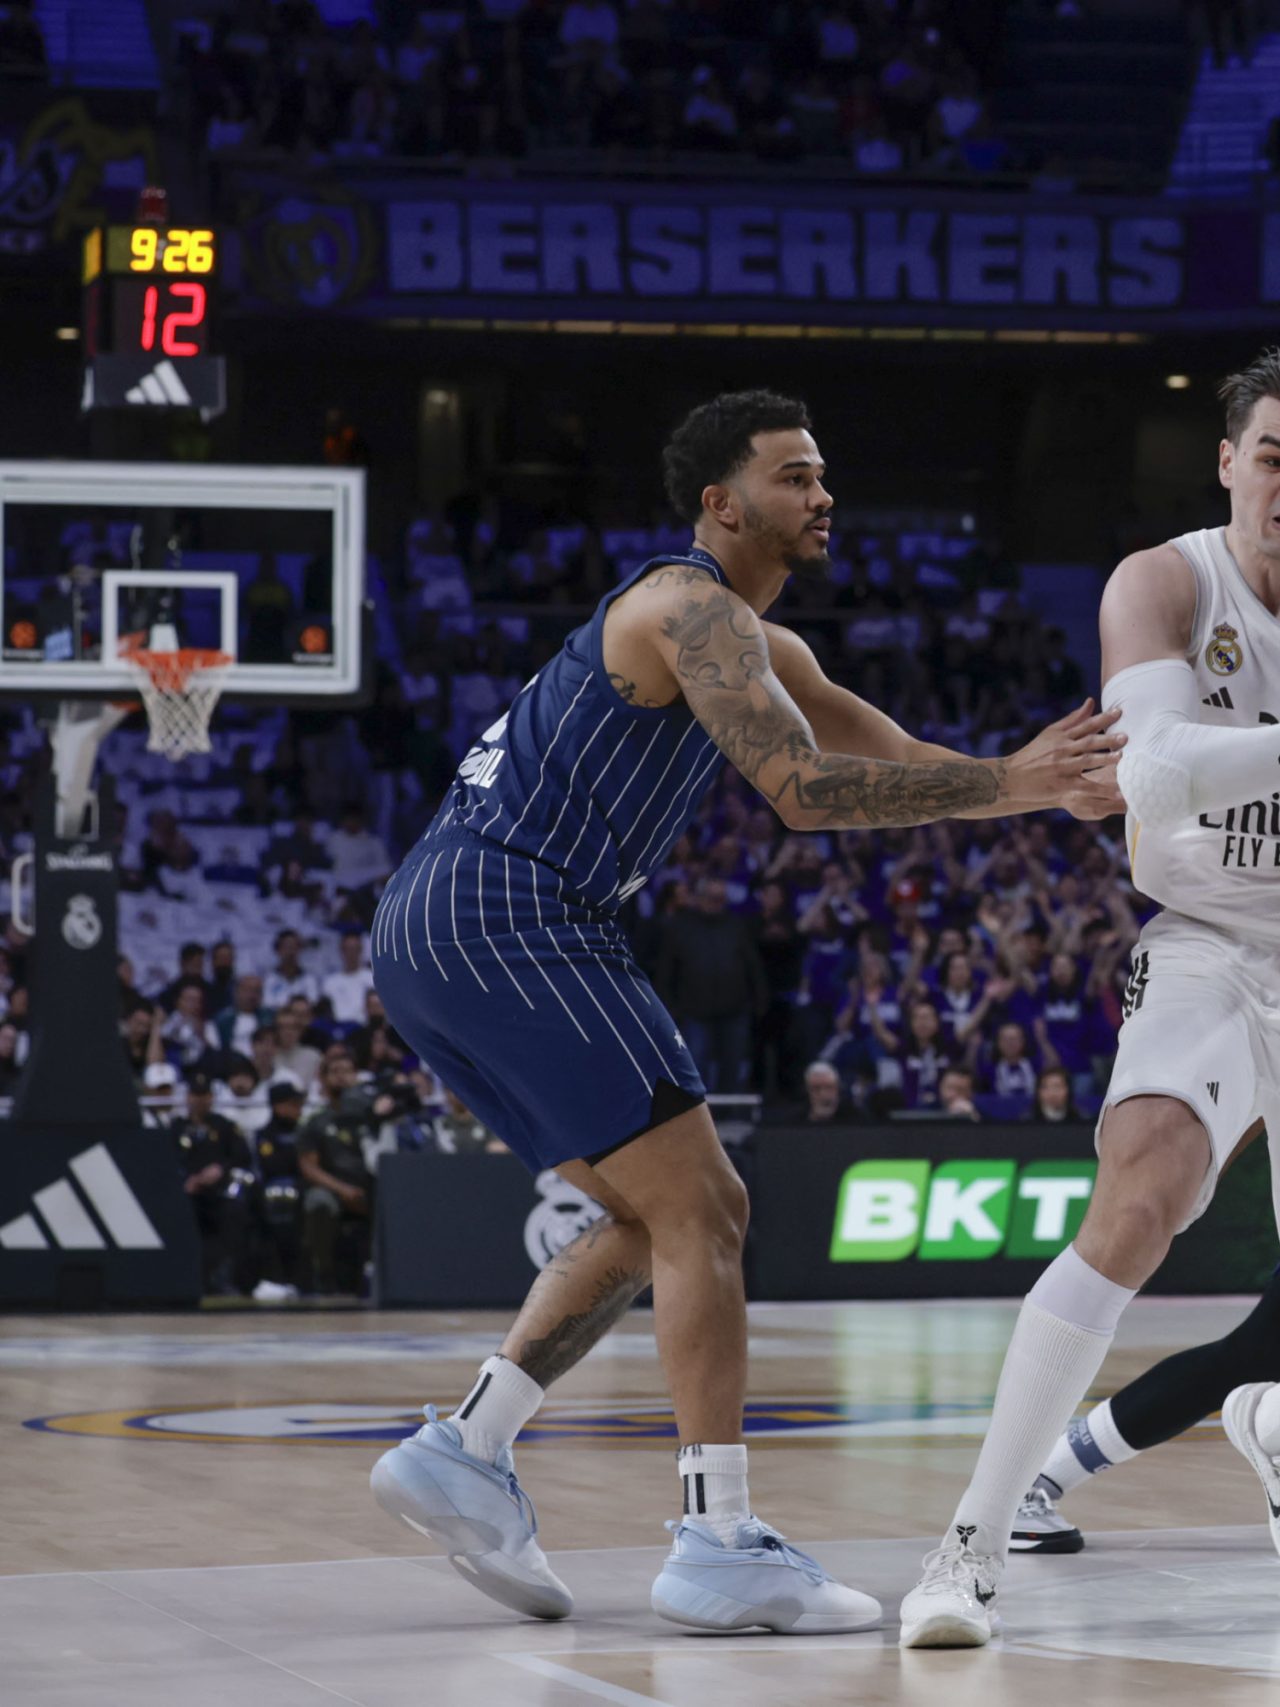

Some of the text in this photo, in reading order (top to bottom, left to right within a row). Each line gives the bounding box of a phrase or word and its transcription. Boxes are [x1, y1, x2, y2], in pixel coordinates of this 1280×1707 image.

[386, 202, 1186, 308] BERSERKERS
[141, 282, 206, 357] 12
[1222, 835, 1264, 868] FLY
[841, 1177, 1093, 1242] BKT
